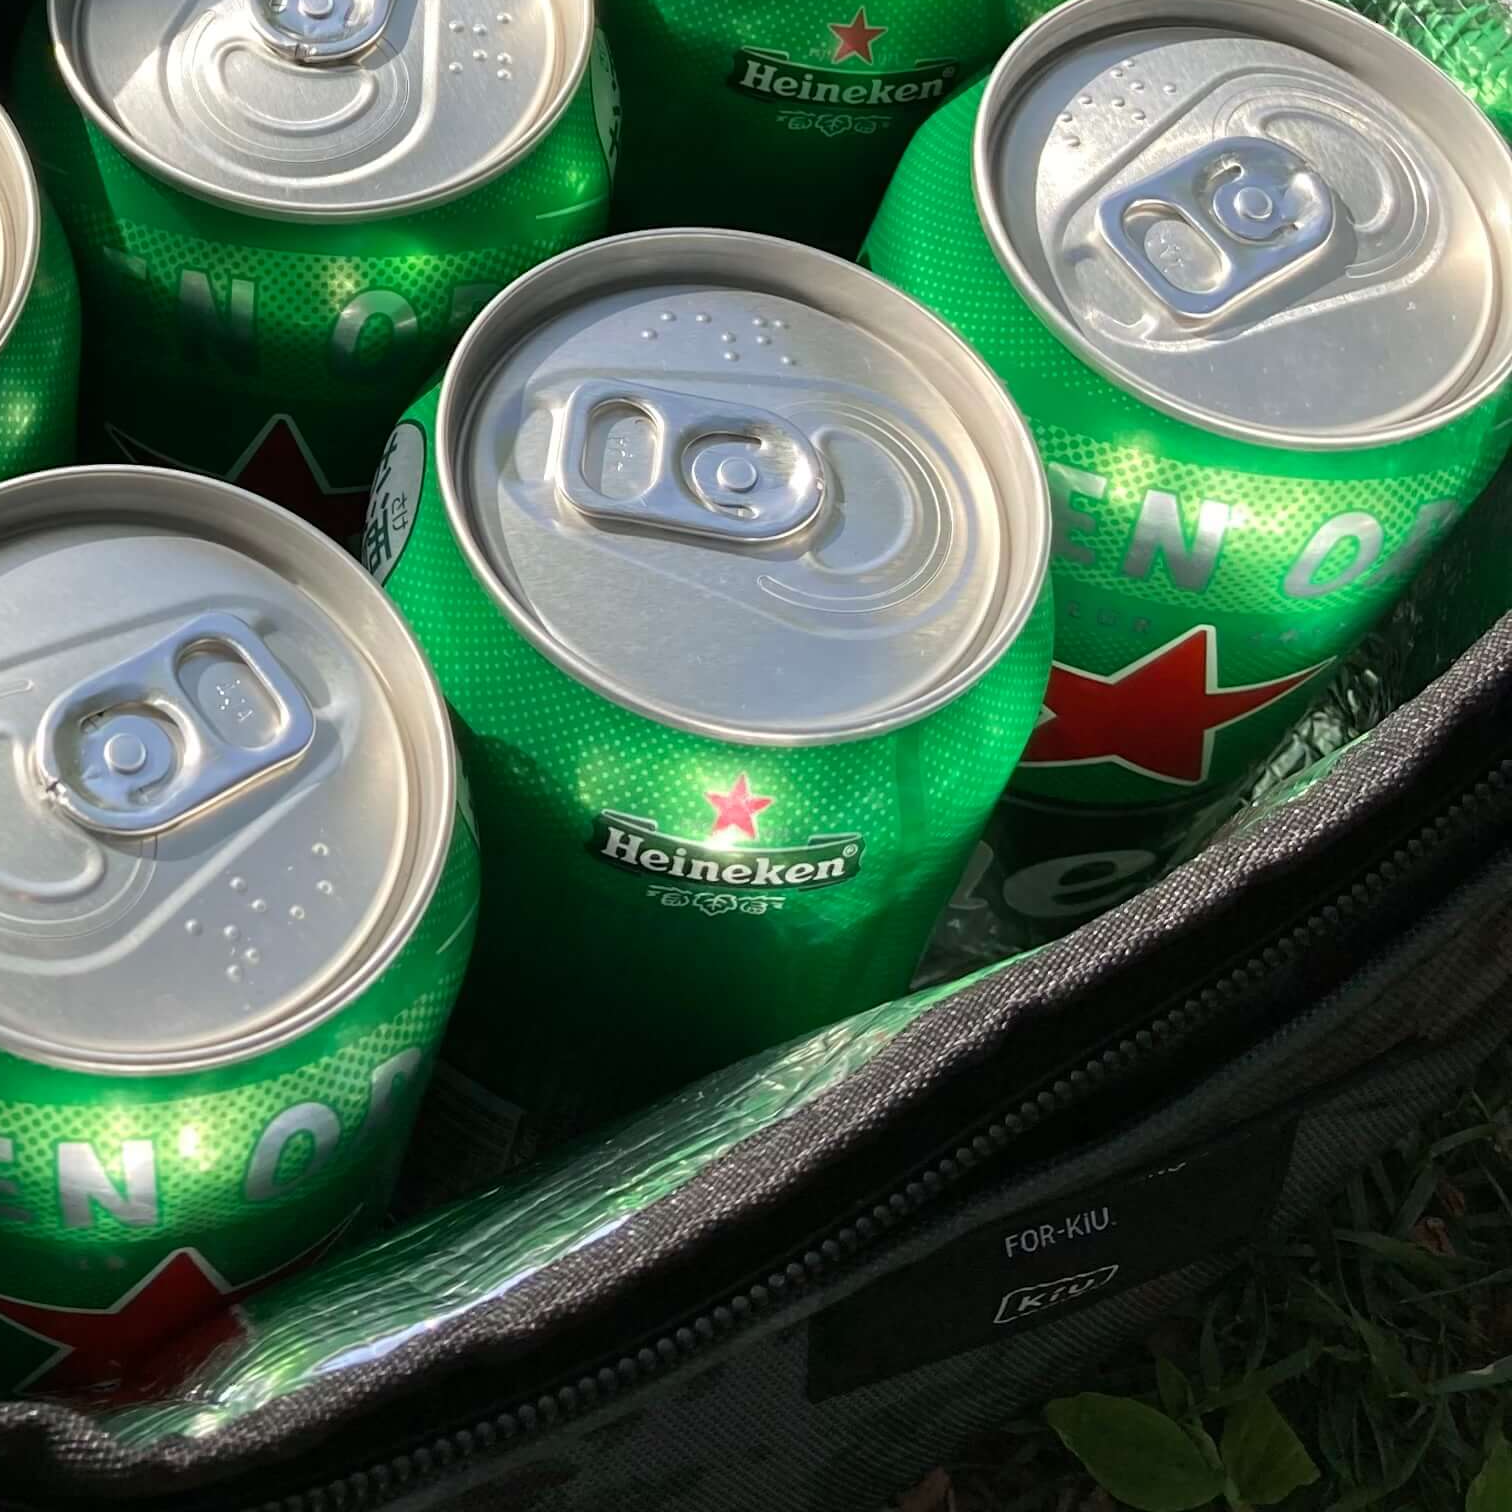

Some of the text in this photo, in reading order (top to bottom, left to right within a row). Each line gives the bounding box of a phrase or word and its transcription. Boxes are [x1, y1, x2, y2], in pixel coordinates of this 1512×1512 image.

[739, 59, 944, 105] Heineken
[391, 491, 409, 531] さけ
[600, 826, 846, 885] Heineken
